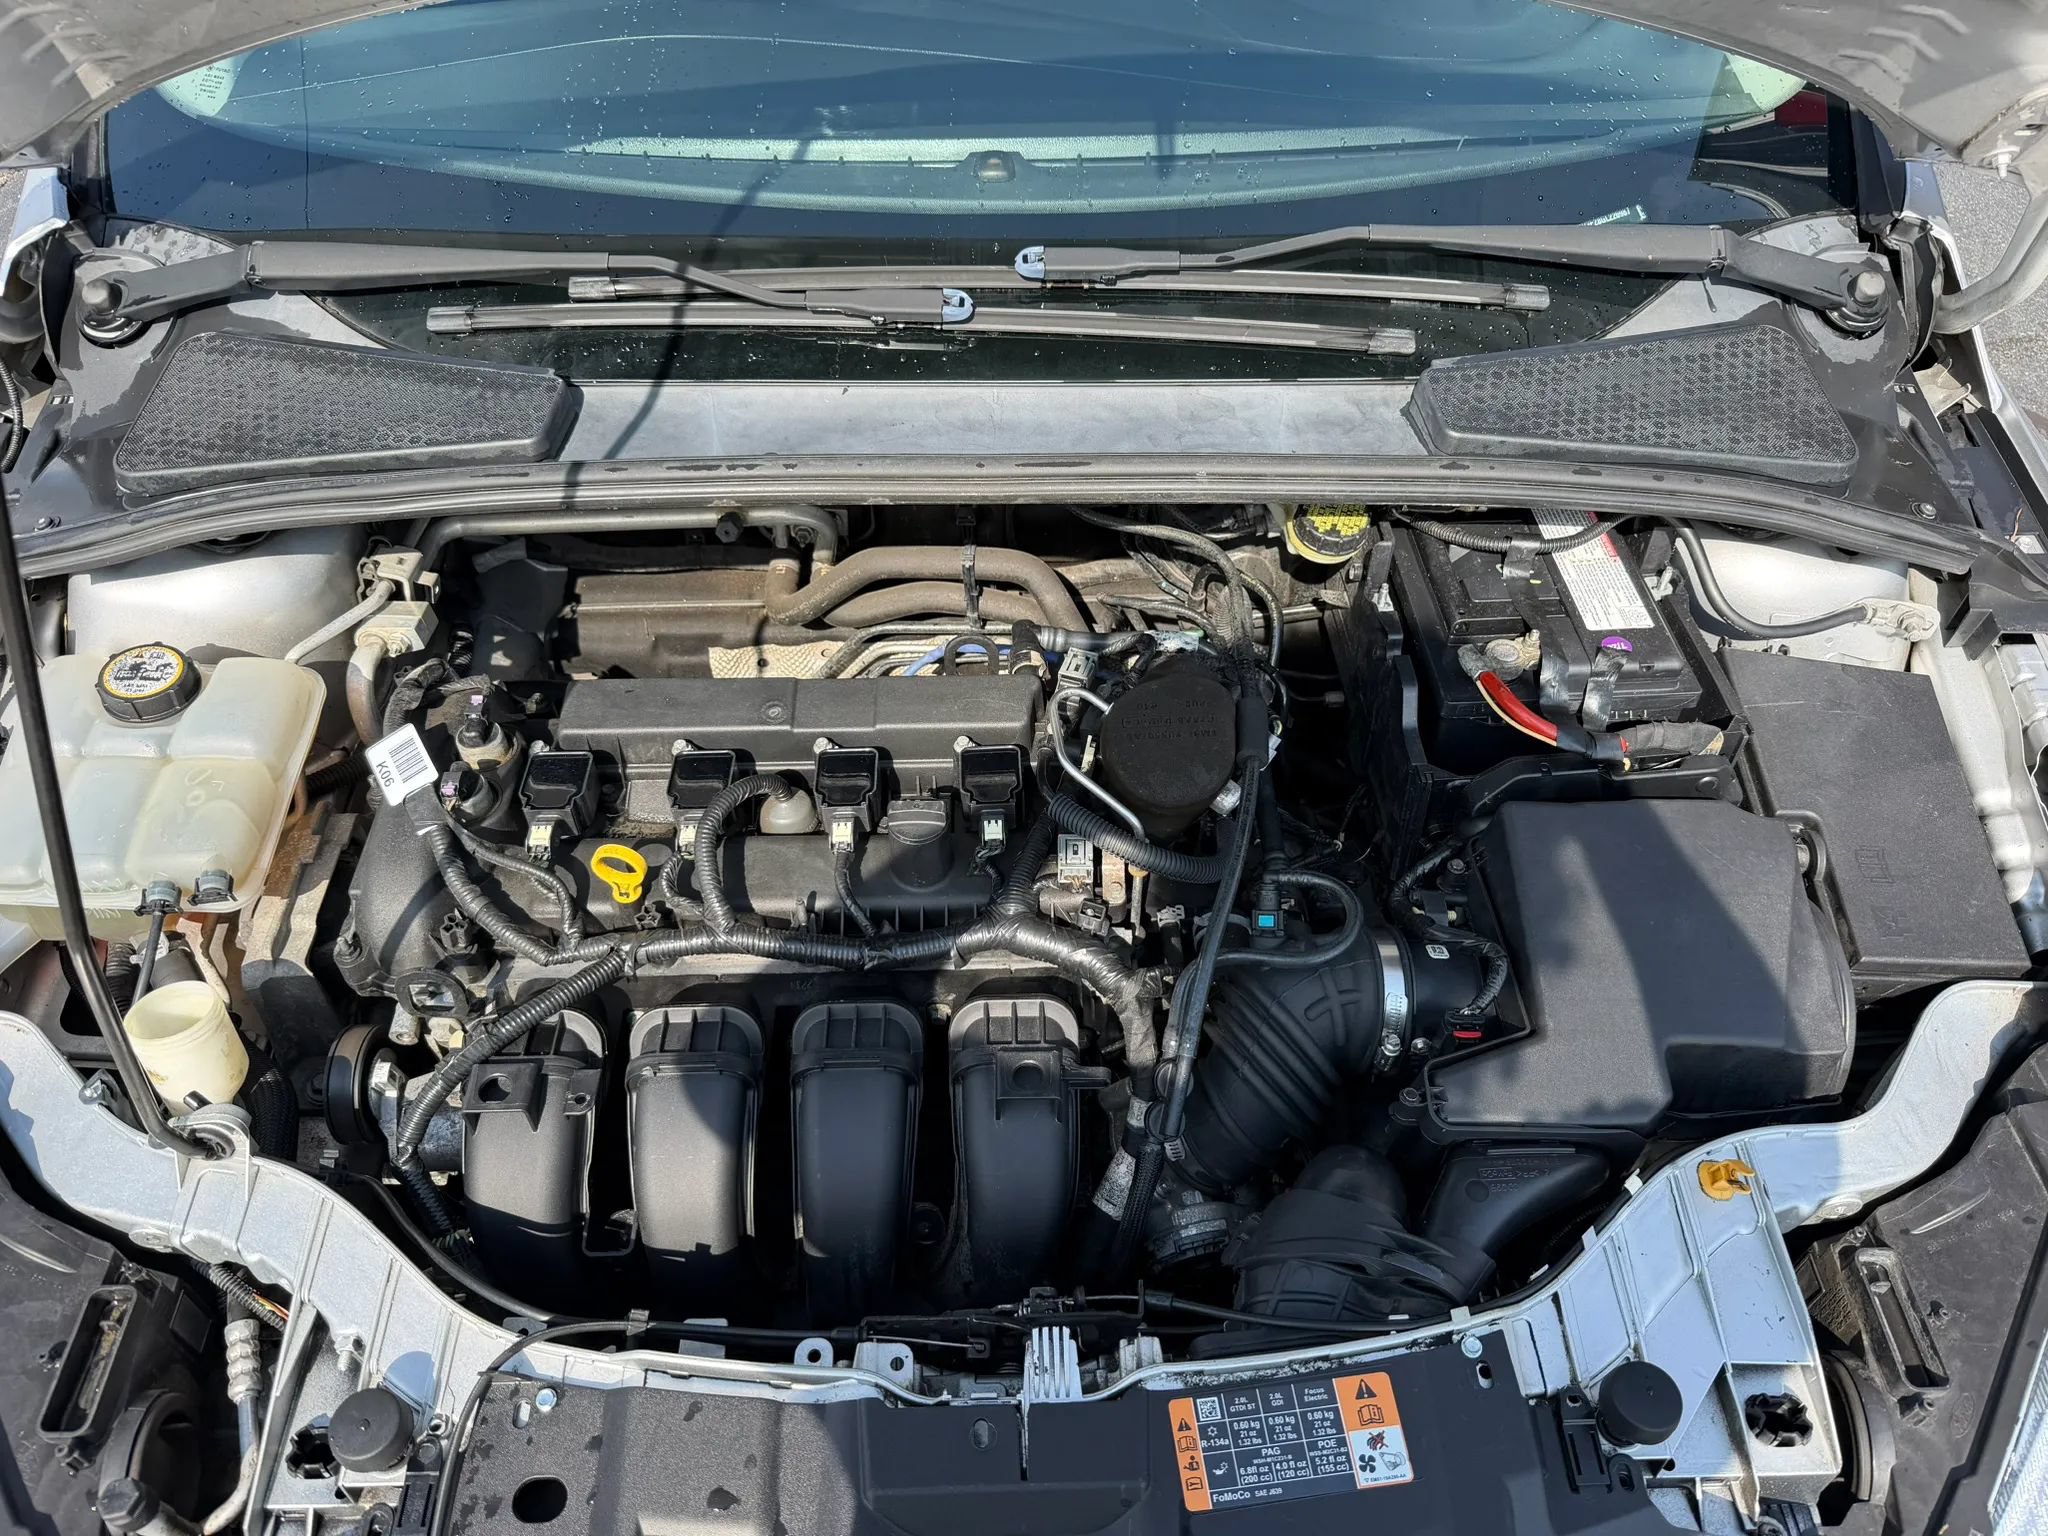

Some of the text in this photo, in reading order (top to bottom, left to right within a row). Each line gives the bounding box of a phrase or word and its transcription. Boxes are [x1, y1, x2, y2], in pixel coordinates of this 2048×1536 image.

[375, 760, 395, 787] K06
[1304, 1387, 1325, 1395] Focus
[1304, 1393, 1329, 1403] Electric
[1230, 1404, 1247, 1412] GTDI
[1268, 1415, 1295, 1425] 0.60 kg
[1307, 1410, 1334, 1421] 0.60 kg
[1233, 1420, 1260, 1430] 0.60 kg
[1273, 1433, 1286, 1441] 1.32
[1312, 1427, 1337, 1437] 1.32 lbs
[1201, 1437, 1230, 1448] R-134a
[1238, 1438, 1251, 1446] 1.32
[1317, 1438, 1338, 1449] POE
[1261, 1447, 1281, 1456] PAG
[1315, 1454, 1347, 1464] 5.2 fl oz
[1259, 1465, 1269, 1473] oz
[1275, 1459, 1307, 1470] 4.0 fl oz
[1317, 1462, 1350, 1475] (155 cc)
[1278, 1467, 1309, 1480] (120 cc)
[1241, 1473, 1273, 1485] (200 cc)
[1212, 1487, 1282, 1503] FoMoCo SAE J639
